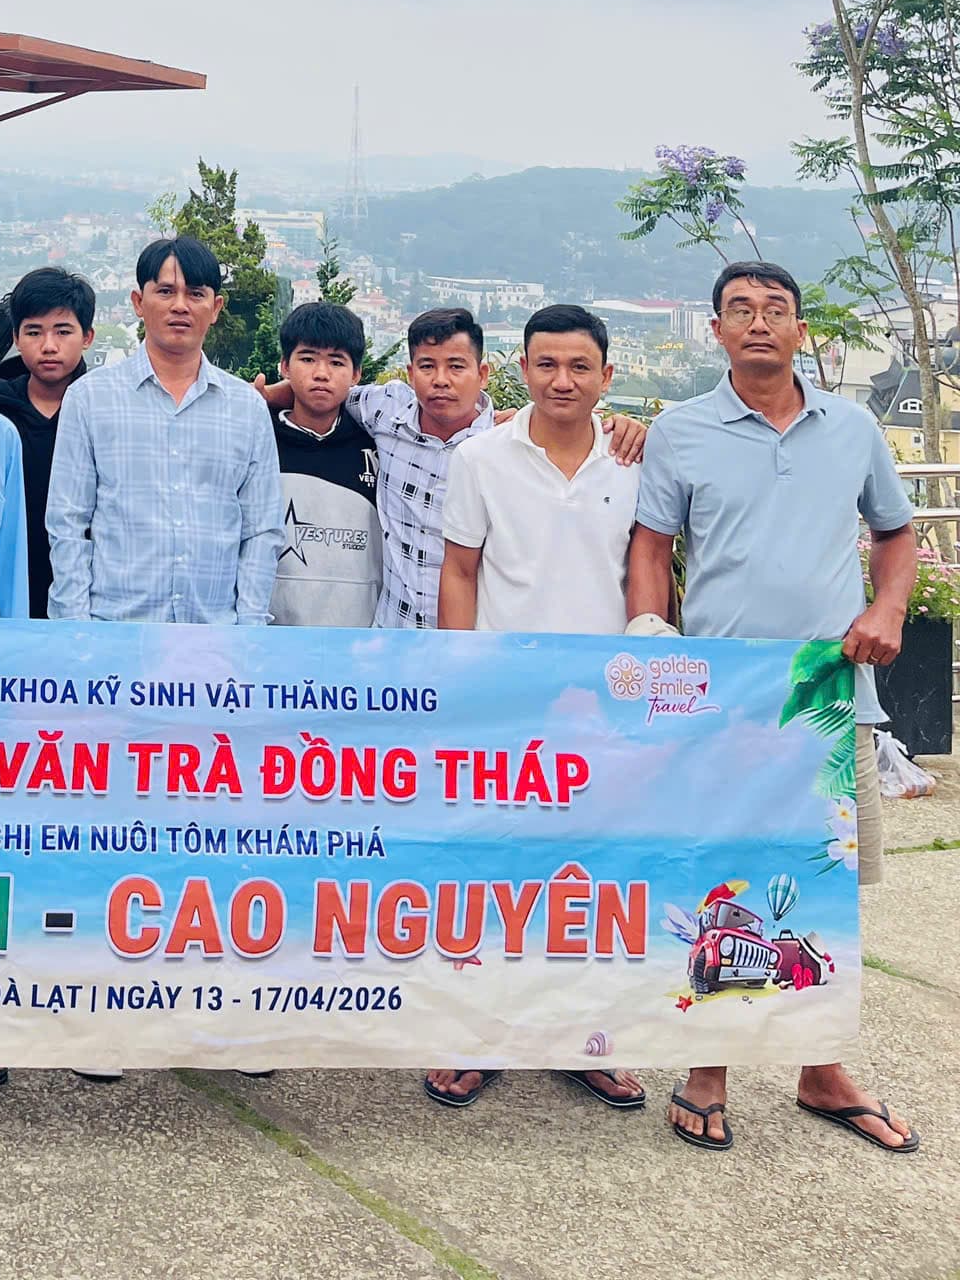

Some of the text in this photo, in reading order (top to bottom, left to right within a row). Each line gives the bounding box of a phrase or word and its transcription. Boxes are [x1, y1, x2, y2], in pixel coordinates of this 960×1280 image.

[295, 526, 369, 549] VESTURES
[649, 656, 708, 680] golden
[0, 677, 79, 705] KHOA
[87, 675, 122, 705] KỸ
[129, 680, 196, 708] SINH
[205, 678, 255, 714] VẬT
[262, 679, 358, 712] THĂNG
[366, 686, 438, 713] LONG
[650, 678, 694, 696] smile
[127, 732, 244, 796] TRÀ
[259, 731, 418, 800] ĐỒNG
[434, 739, 591, 806] THÁP
[41, 824, 81, 851] EM
[90, 820, 158, 853] NUÔI
[165, 821, 227, 854] TÔM
[237, 823, 319, 857] KHÁM
[327, 825, 386, 858] PHÁ
[45, 912, 74, 928] -
[107, 876, 287, 955] CAO
[313, 862, 647, 956] NGUYÊN
[31, 985, 84, 1015] LẠT
[106, 980, 183, 1010] NGÀY
[192, 986, 224, 1011] 13
[251, 985, 402, 1013] 17/04/2026
